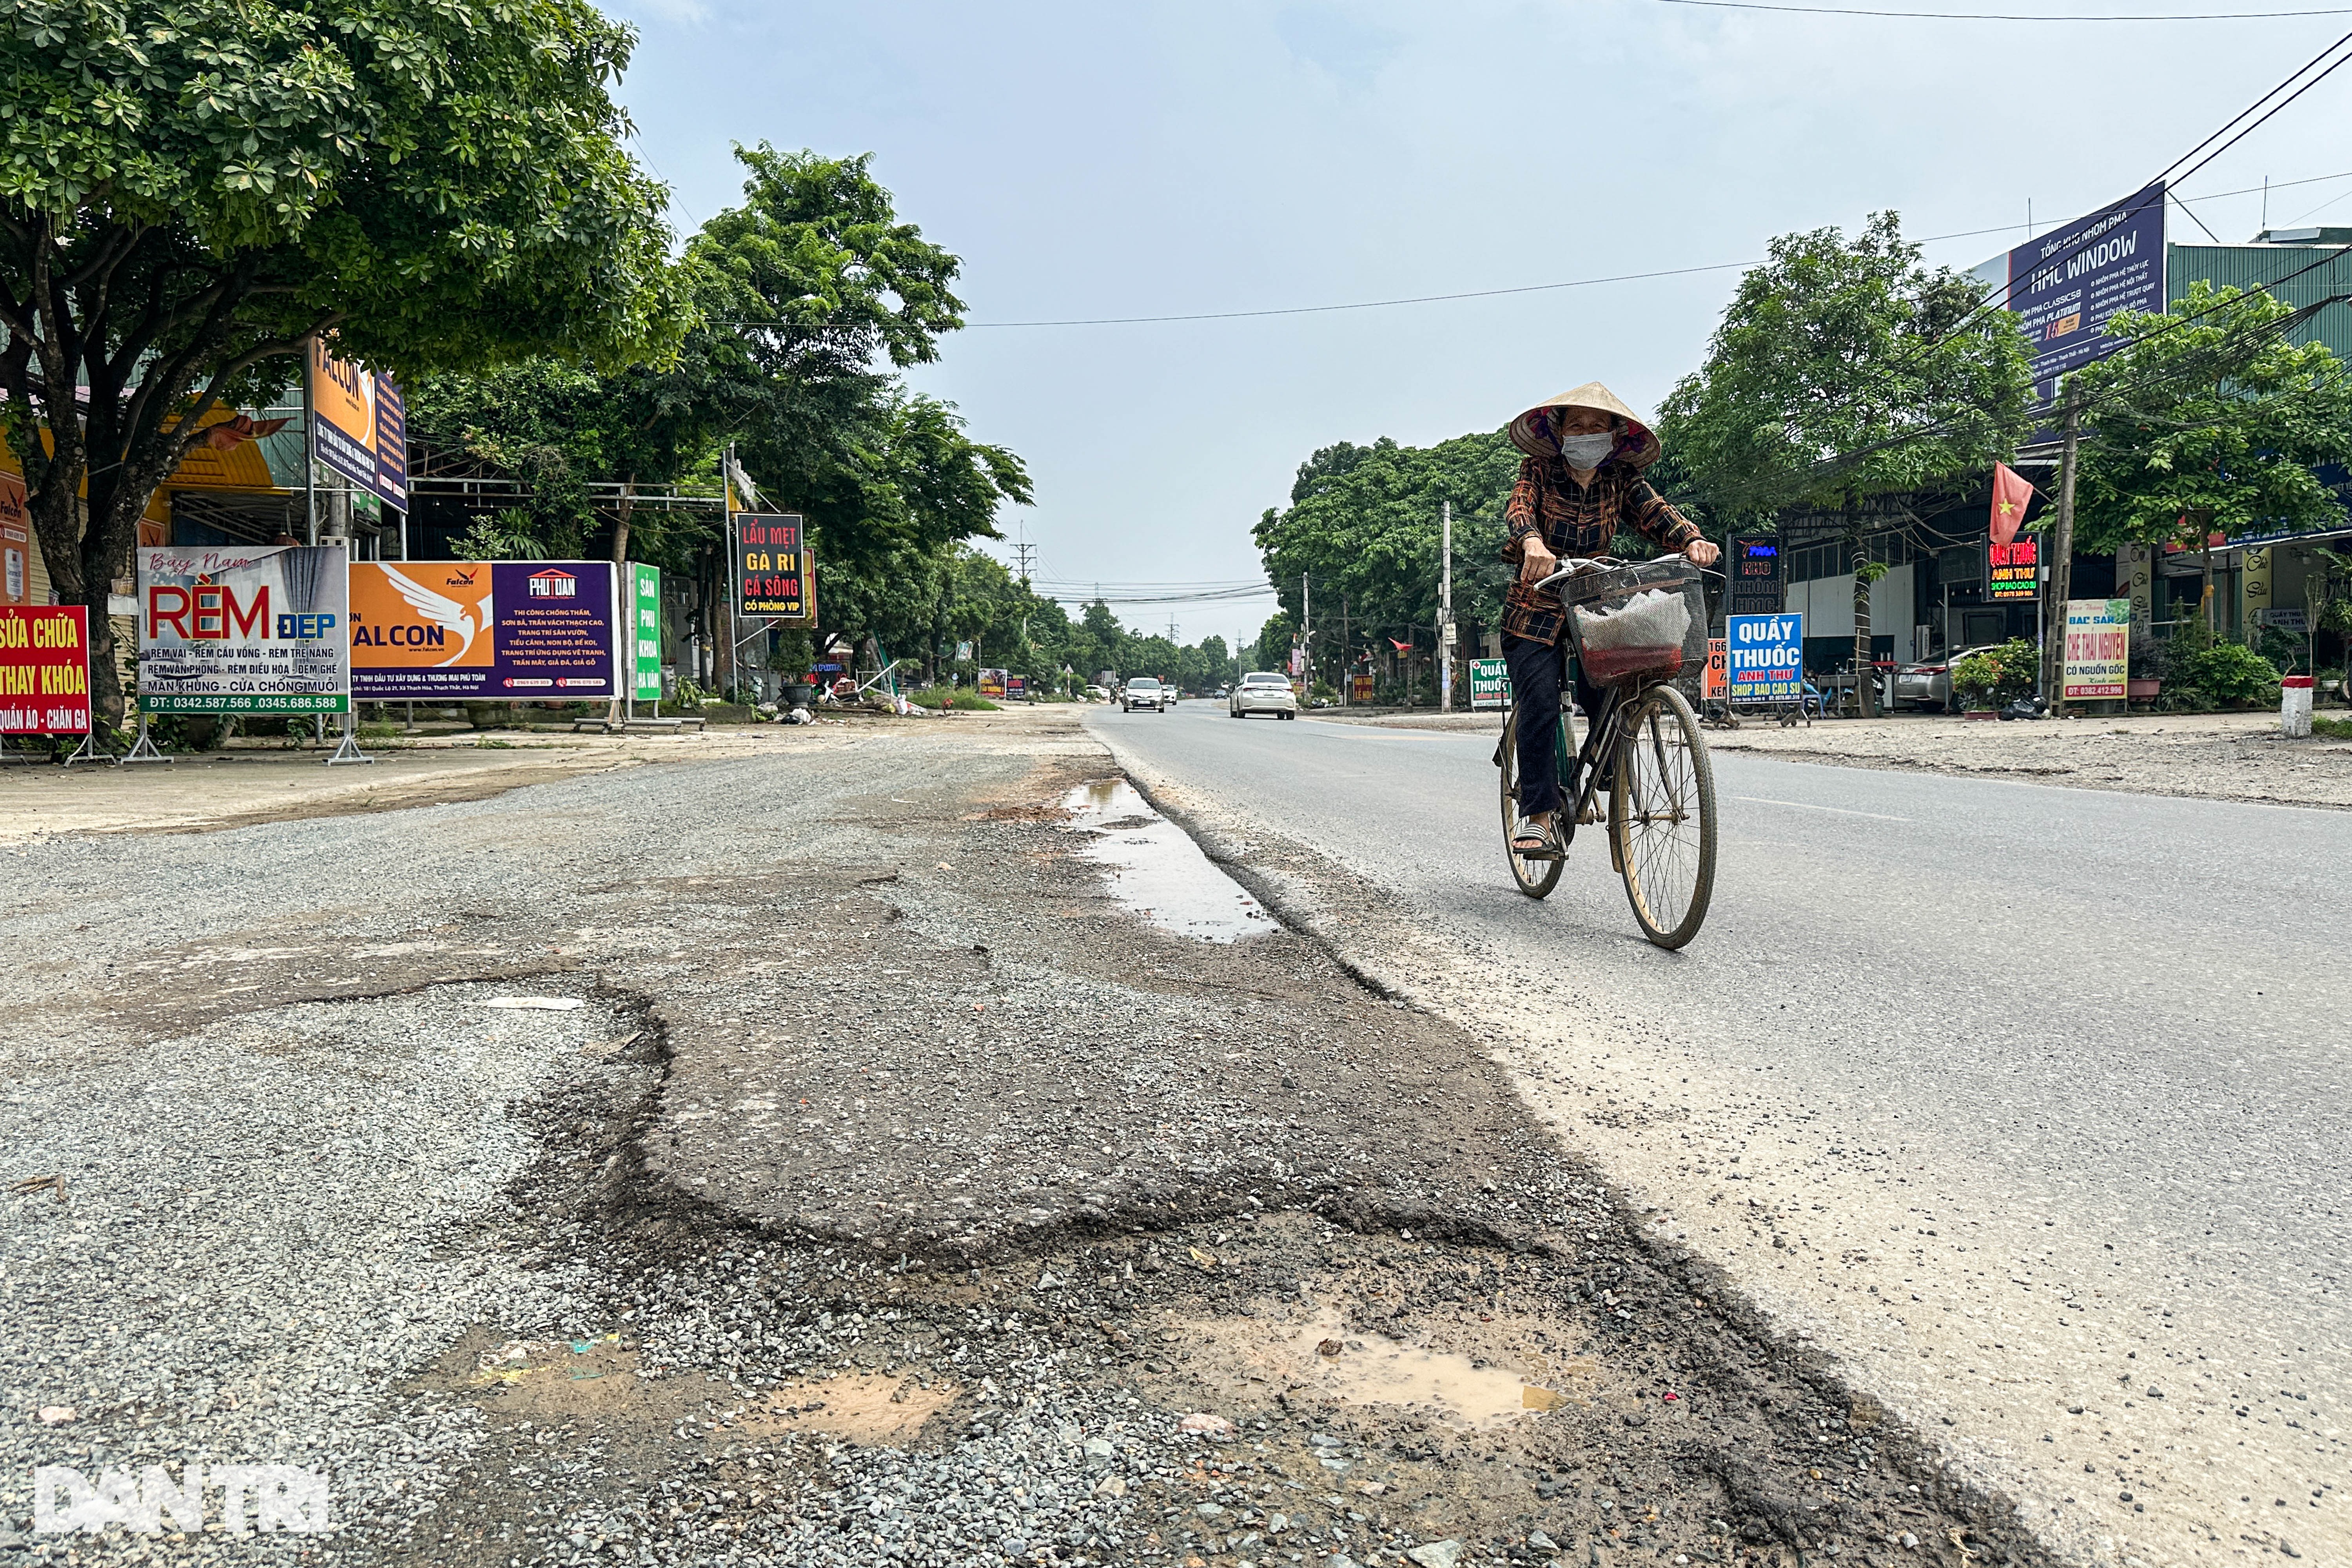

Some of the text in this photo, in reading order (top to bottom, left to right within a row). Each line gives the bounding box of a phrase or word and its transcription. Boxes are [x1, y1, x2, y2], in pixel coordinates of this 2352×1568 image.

[2031, 230, 2137, 294] HMC WINDOW
[2043, 289, 2081, 310] CLASSIC58
[2044, 321, 2059, 341] 15
[0, 500, 22, 519] Falcon
[743, 518, 796, 550] LẨU MẸT
[2011, 535, 2036, 564] THUỐC
[150, 552, 255, 576] Bảy Nam
[746, 549, 795, 571] GÀ RI
[1742, 561, 1771, 575] KHO
[2246, 555, 2268, 572] Chè
[1992, 567, 2036, 580] ANH THƯ
[640, 573, 655, 598] SẢN
[745, 574, 798, 596] CÁ SÔNG
[1734, 577, 1778, 594] NHÔM
[1991, 581, 2036, 590] SHOP BAO CAO SU
[149, 573, 270, 639] RÈM
[744, 599, 800, 611] CÓ PHÒNG VIP
[1736, 598, 1775, 613] HMC
[33, 612, 78, 648] CHỮA
[277, 613, 336, 644] ĐẸP
[641, 609, 655, 632] PHỤ
[1739, 616, 1794, 643] QUẦY
[352, 625, 445, 646] ALCON
[2067, 627, 2080, 661] CHÈ
[2082, 627, 2097, 661] THÁI
[2098, 626, 2125, 661] NGUYÊN
[151, 646, 170, 658] RÈM
[195, 647, 214, 658] RÈM
[269, 646, 288, 658] RÈM
[290, 648, 307, 658] TRE
[639, 640, 657, 658] KHOA
[1732, 641, 1800, 668] THUỐC
[0, 659, 86, 695] THAY KHÓA
[148, 662, 166, 674] RÈM
[228, 662, 247, 674] RÈM
[360, 674, 373, 682] TNHH
[387, 673, 395, 682] TƯ
[1738, 670, 1765, 682] ANH
[1769, 668, 1795, 681] THƯ
[2066, 665, 2077, 675] CÓ
[2109, 662, 2125, 674] GỐC
[230, 677, 255, 691] CỬA
[259, 675, 304, 691] CHỐNG
[1731, 682, 1800, 697] SHOP BAO CAO SU
[150, 697, 170, 708] ĐT:
[174, 697, 251, 708] 0342.587.566
[26, 705, 38, 729] ÁO
[47, 705, 68, 729] CHĂN
[74, 709, 87, 729] GA
